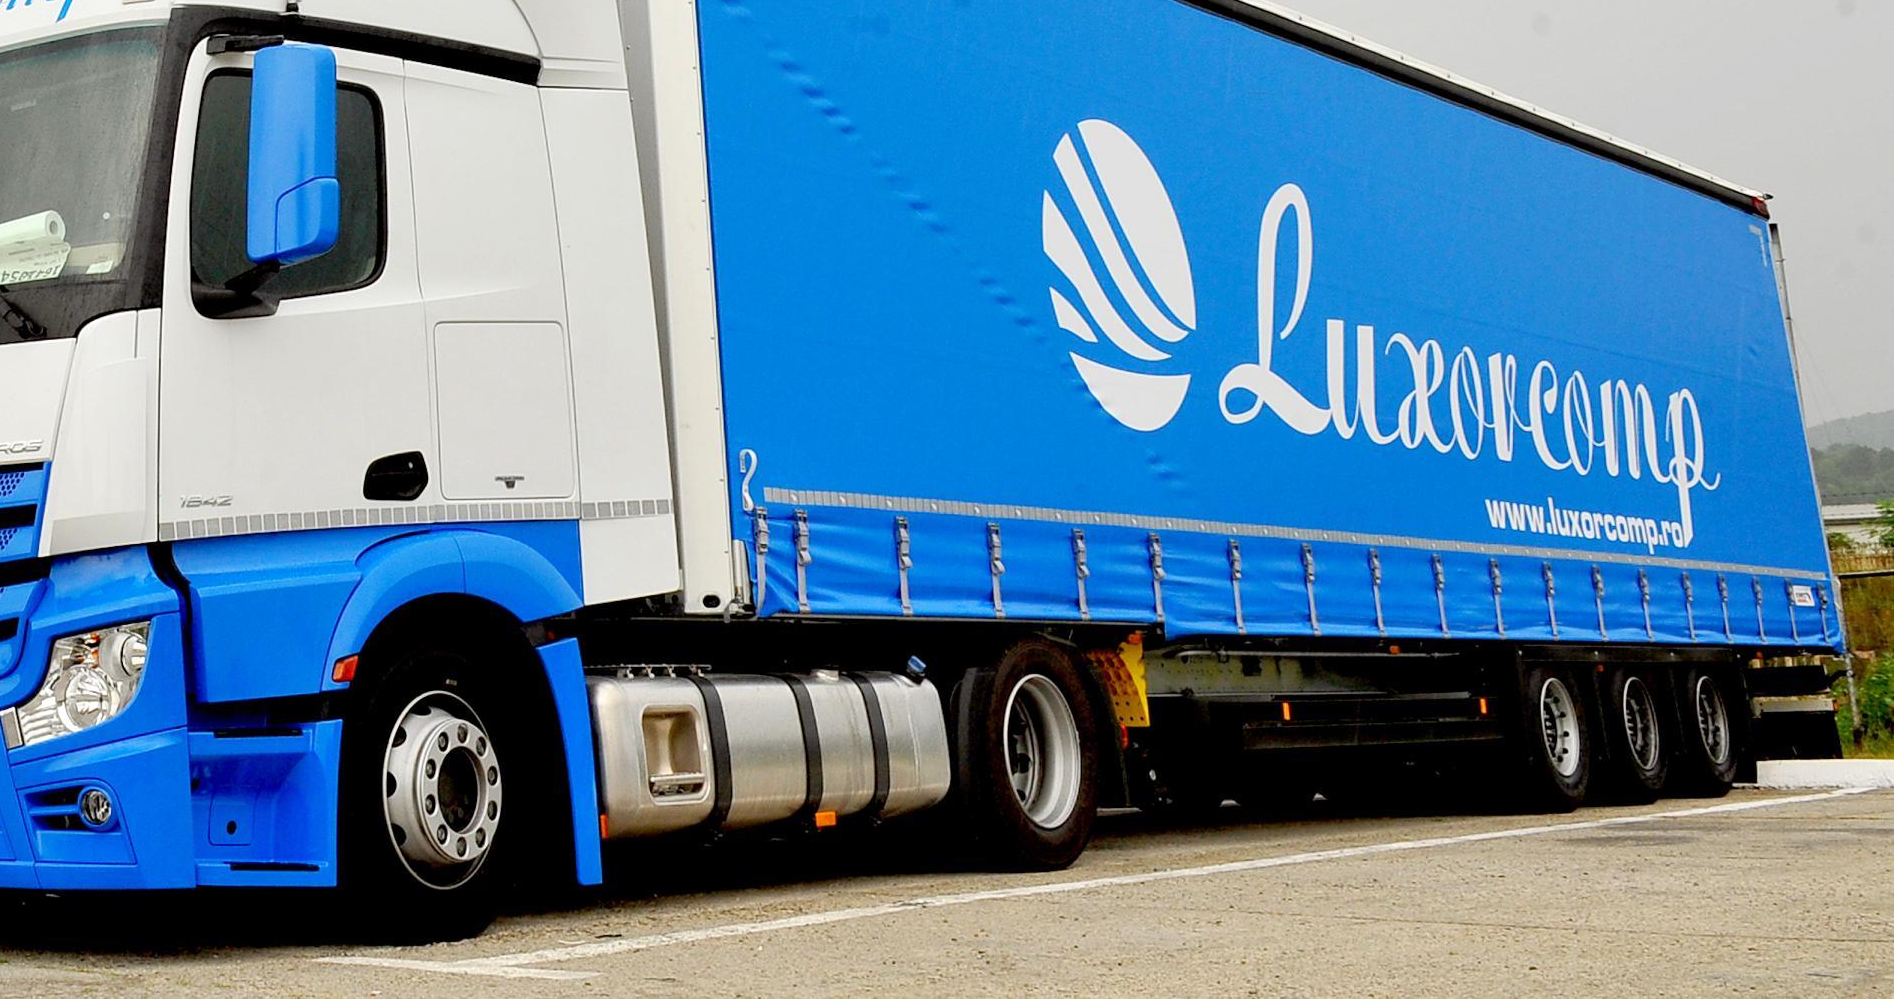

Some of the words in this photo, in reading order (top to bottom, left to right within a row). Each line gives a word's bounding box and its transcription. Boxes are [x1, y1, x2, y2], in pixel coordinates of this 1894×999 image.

[1218, 183, 1721, 548] Luxorcomp
[180, 495, 233, 508] 1842
[1485, 497, 1683, 554] www.luxorcomp.ro
